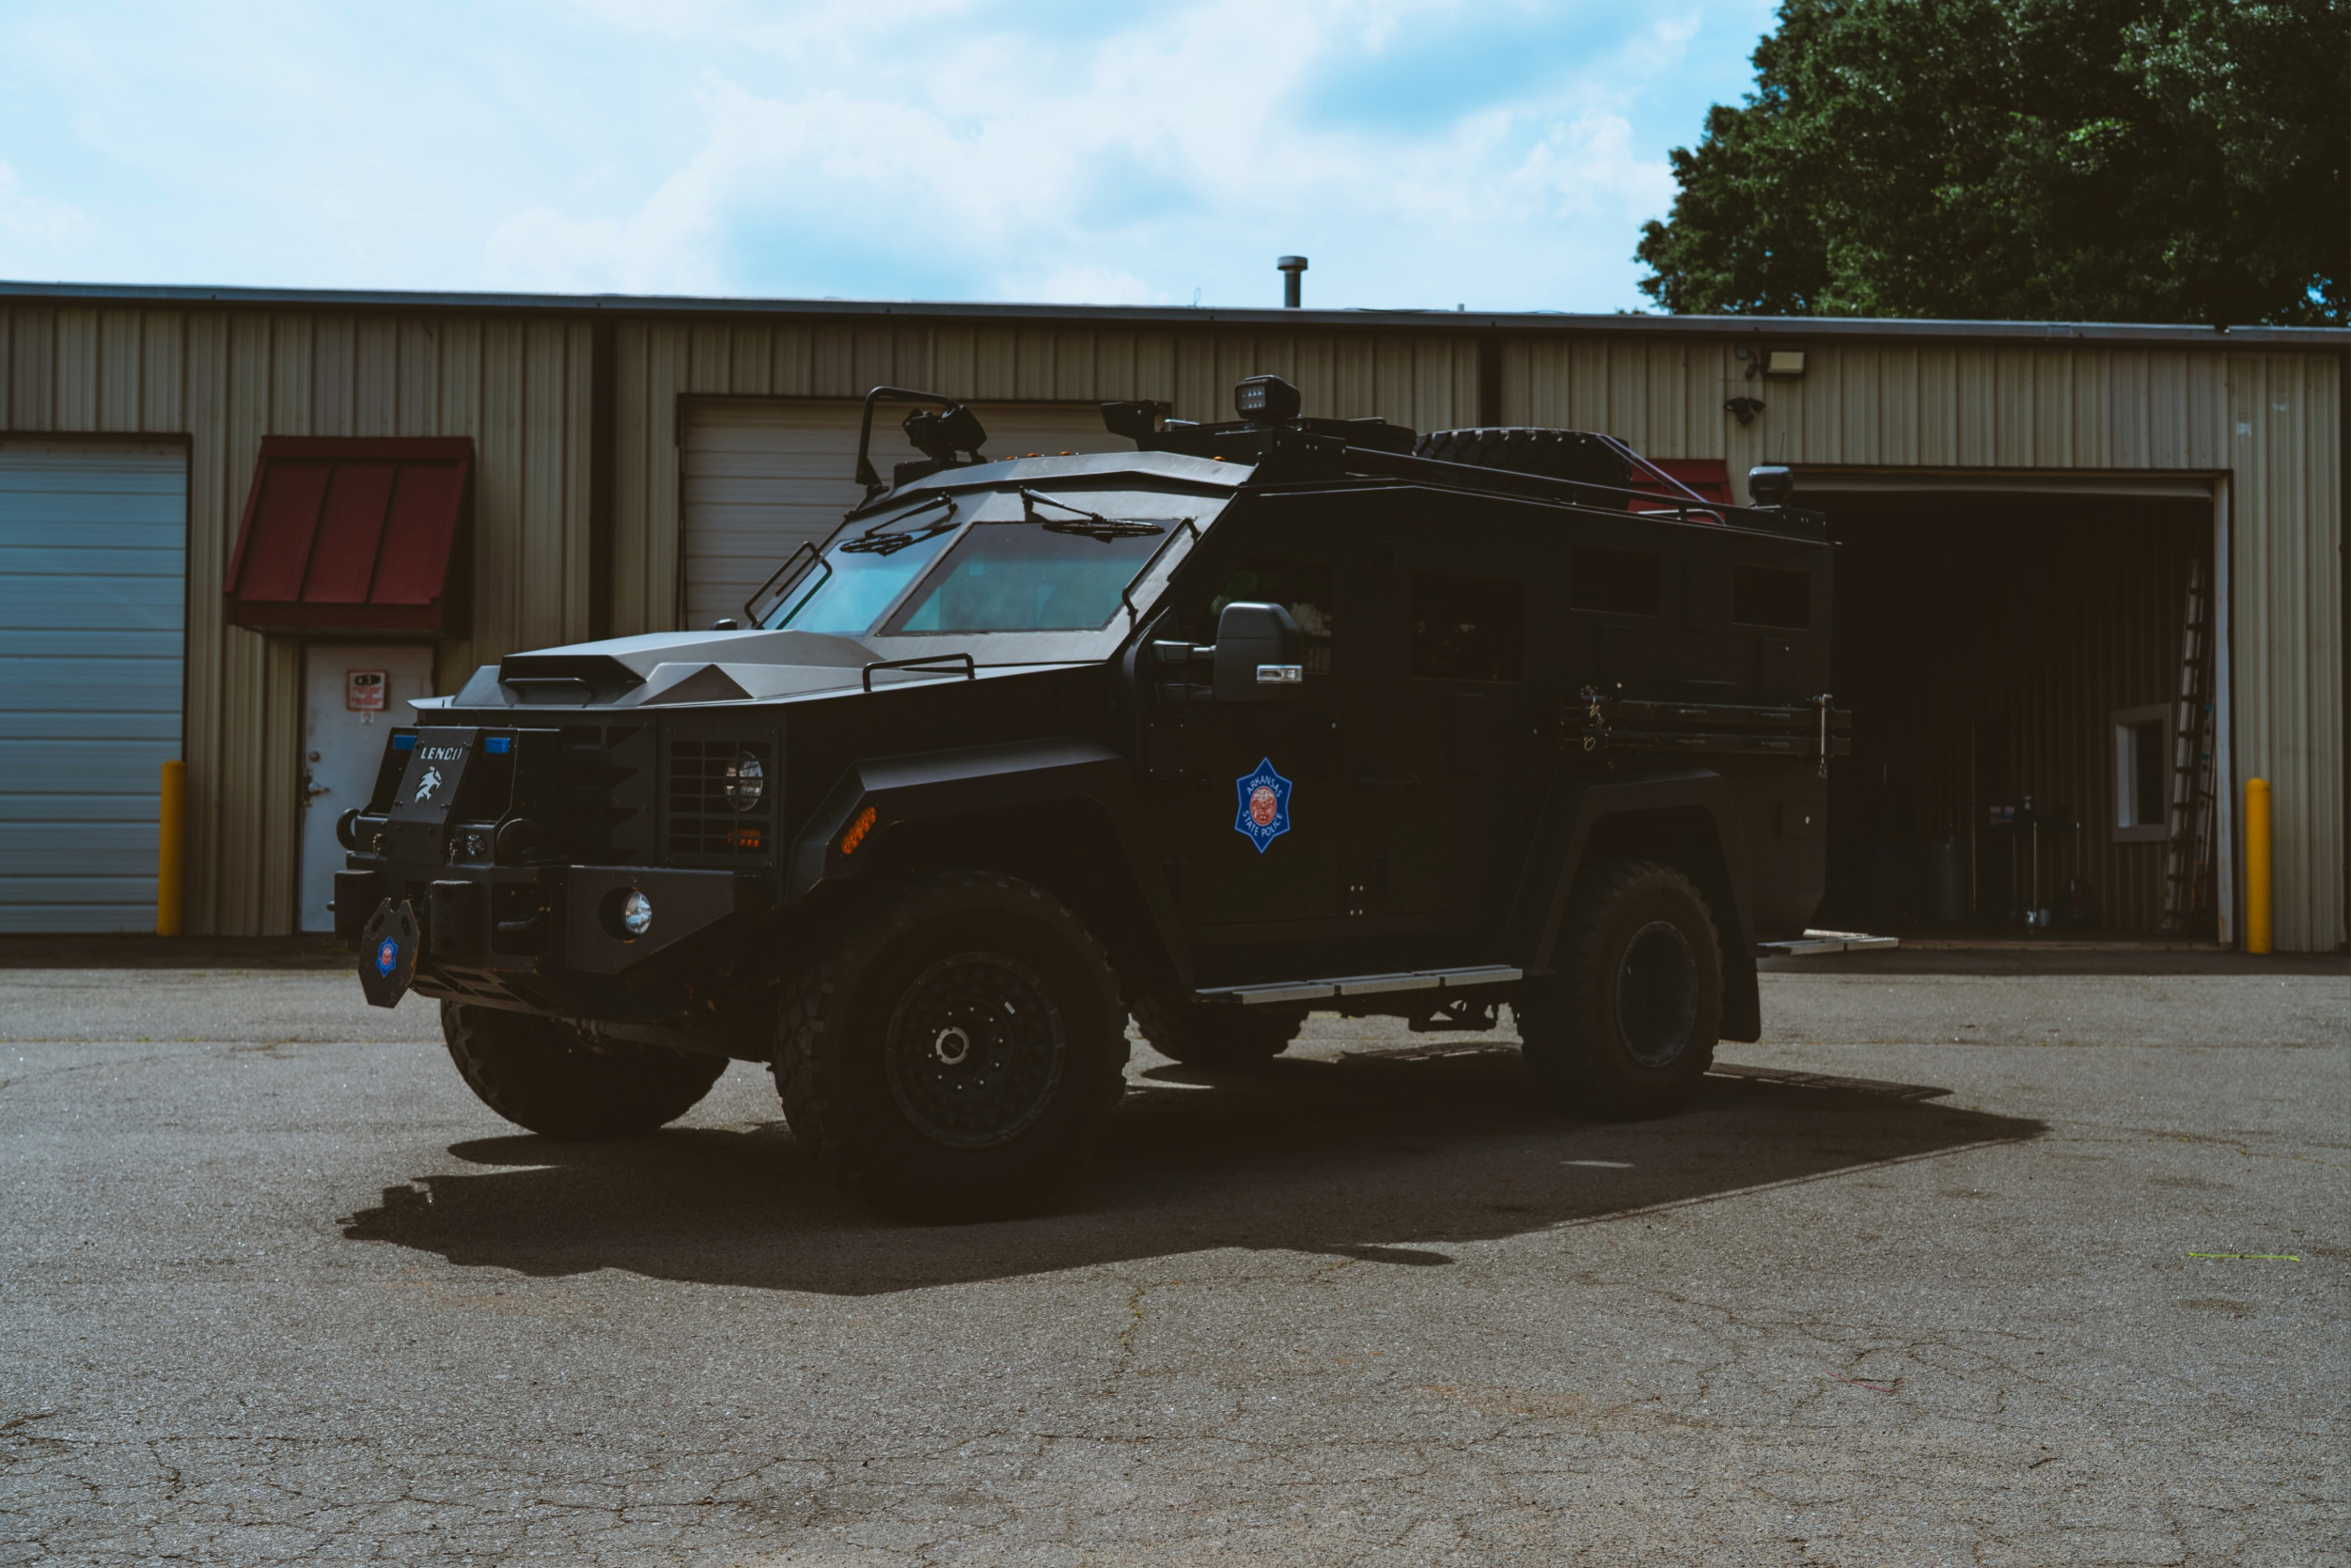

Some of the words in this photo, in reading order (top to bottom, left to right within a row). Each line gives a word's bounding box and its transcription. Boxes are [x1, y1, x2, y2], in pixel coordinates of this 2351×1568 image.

[420, 746, 462, 760] LENCO
[1246, 775, 1283, 797] ARKANSAS
[1242, 809, 1259, 837] STATE
[1261, 812, 1283, 838] POLICE
